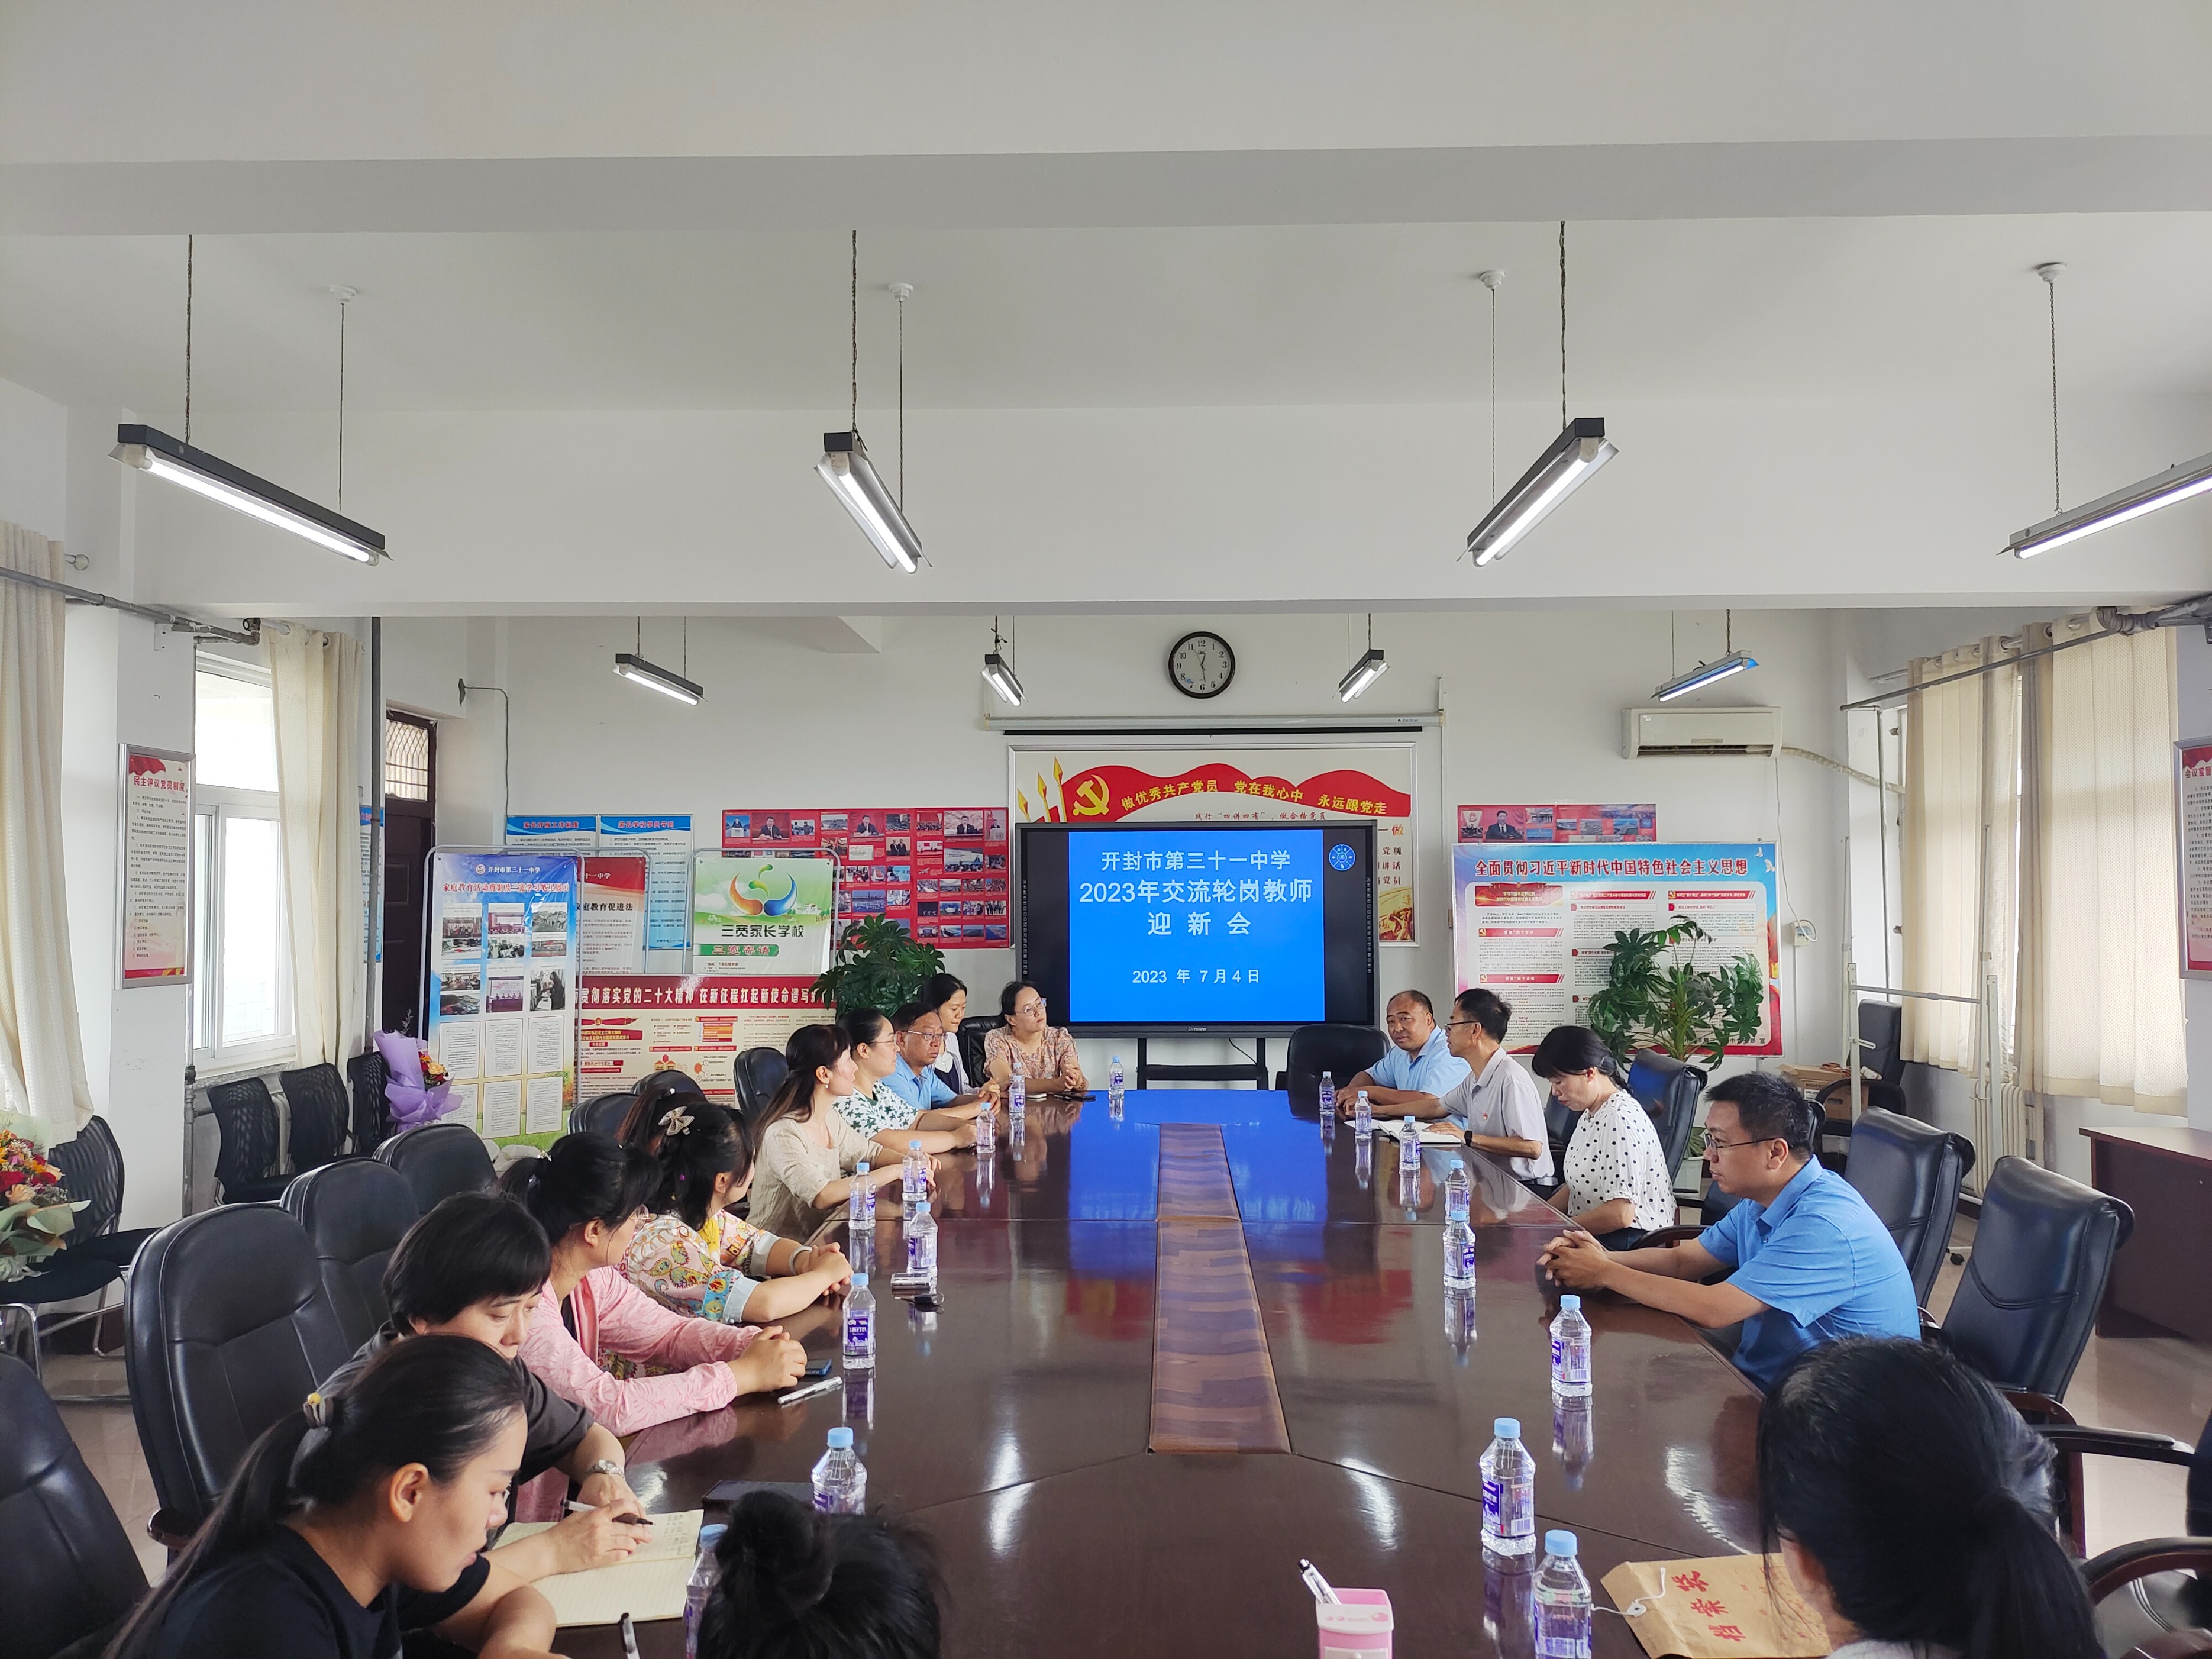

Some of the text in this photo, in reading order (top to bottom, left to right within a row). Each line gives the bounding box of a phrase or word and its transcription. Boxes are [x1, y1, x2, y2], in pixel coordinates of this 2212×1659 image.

[134, 776, 185, 792] 民主评议党员制度
[1121, 780, 1387, 815] 做优秀共产党员 党在我心中 永远跟党走
[1101, 850, 1291, 872] 开封市第三十一中学
[1378, 861, 1401, 870] 讲话
[1475, 858, 1748, 877] 全面贯彻习近平新时代中国特色社会主义思想
[1079, 879, 1313, 904] 2023年交流轮岗教师
[721, 924, 805, 938] 三宽家长学校
[712, 945, 771, 955] 三宽寄语
[1132, 970, 1167, 984] 2023
